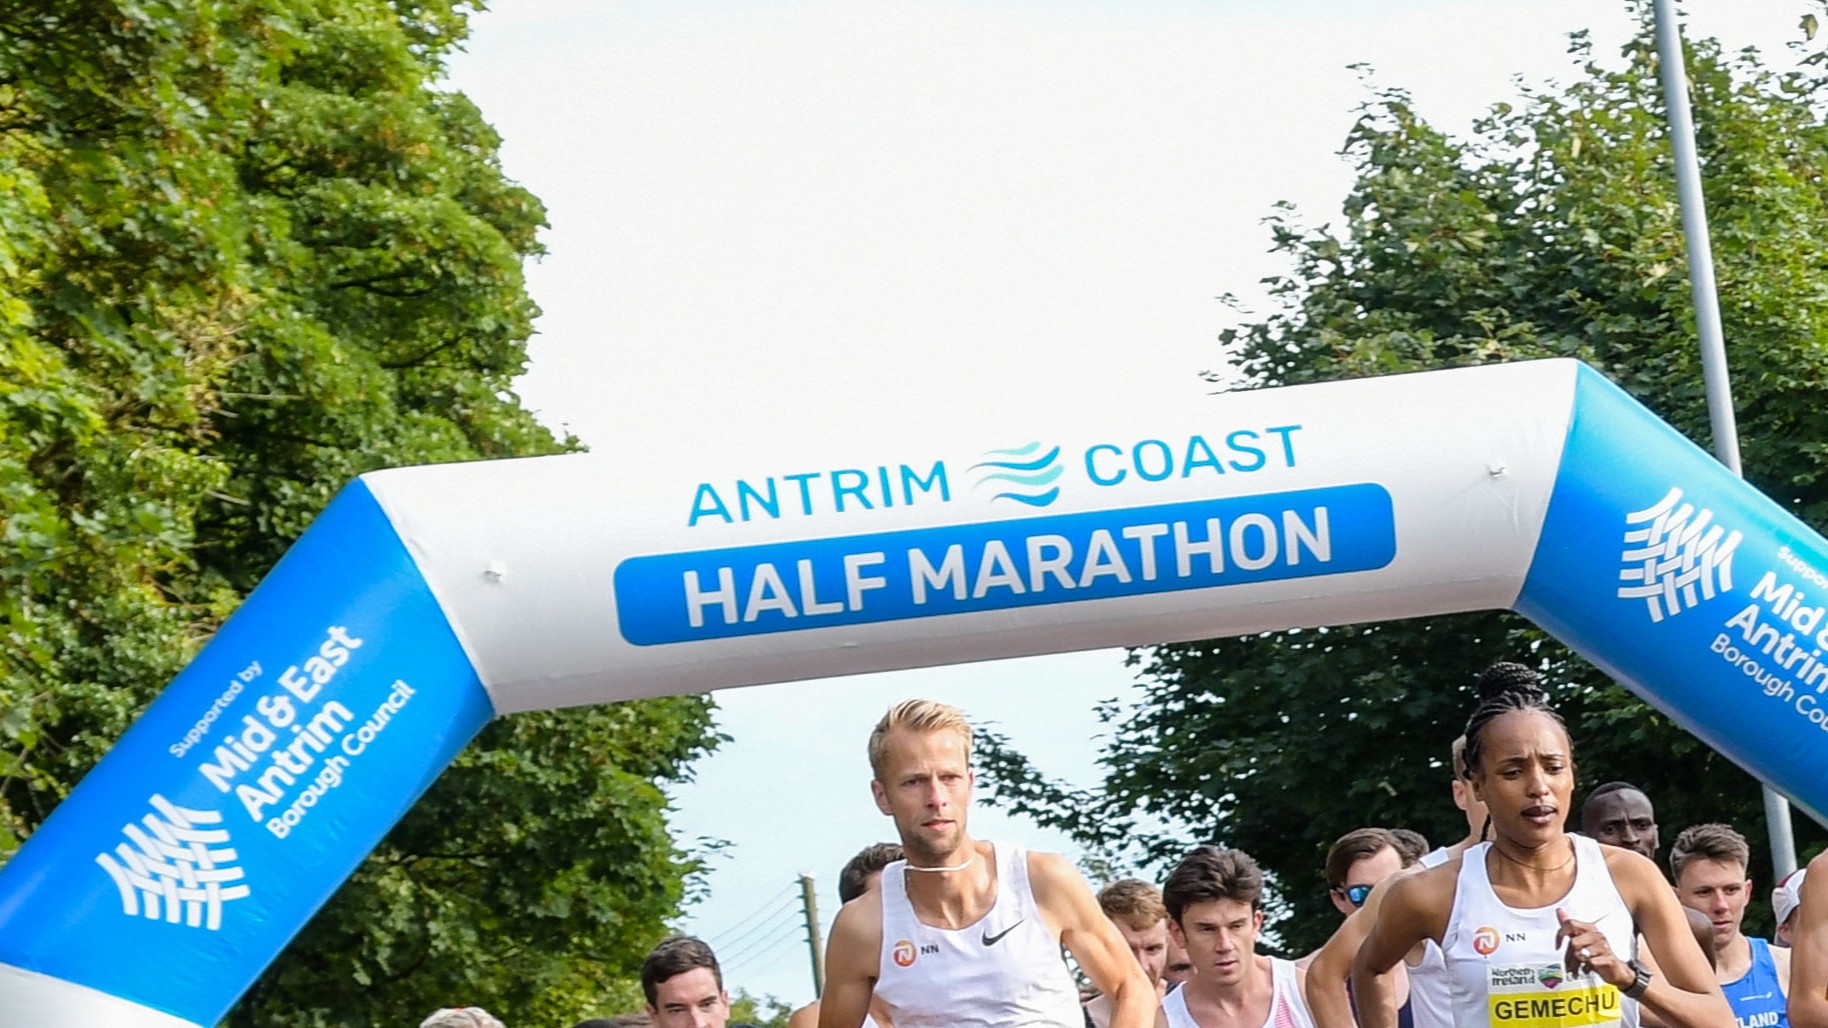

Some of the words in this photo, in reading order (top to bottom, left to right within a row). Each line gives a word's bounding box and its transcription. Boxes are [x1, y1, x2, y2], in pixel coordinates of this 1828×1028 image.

[687, 459, 952, 528] ANTRIM
[1084, 425, 1303, 486] COAST
[683, 551, 888, 629] HALF
[908, 506, 1331, 605] MARATHON
[1749, 572, 1826, 637] Mid
[169, 679, 243, 758] Supported
[237, 660, 264, 684] by
[199, 714, 276, 794] Mid
[256, 694, 295, 728] &
[277, 625, 363, 703] East
[1709, 632, 1797, 704] Borough
[236, 700, 354, 823] Antrim
[266, 747, 350, 840] Borough
[341, 679, 416, 757] Council
[920, 944, 939, 955] NN
[1505, 933, 1526, 942] NN
[1495, 992, 1615, 1020] GEMECHU
